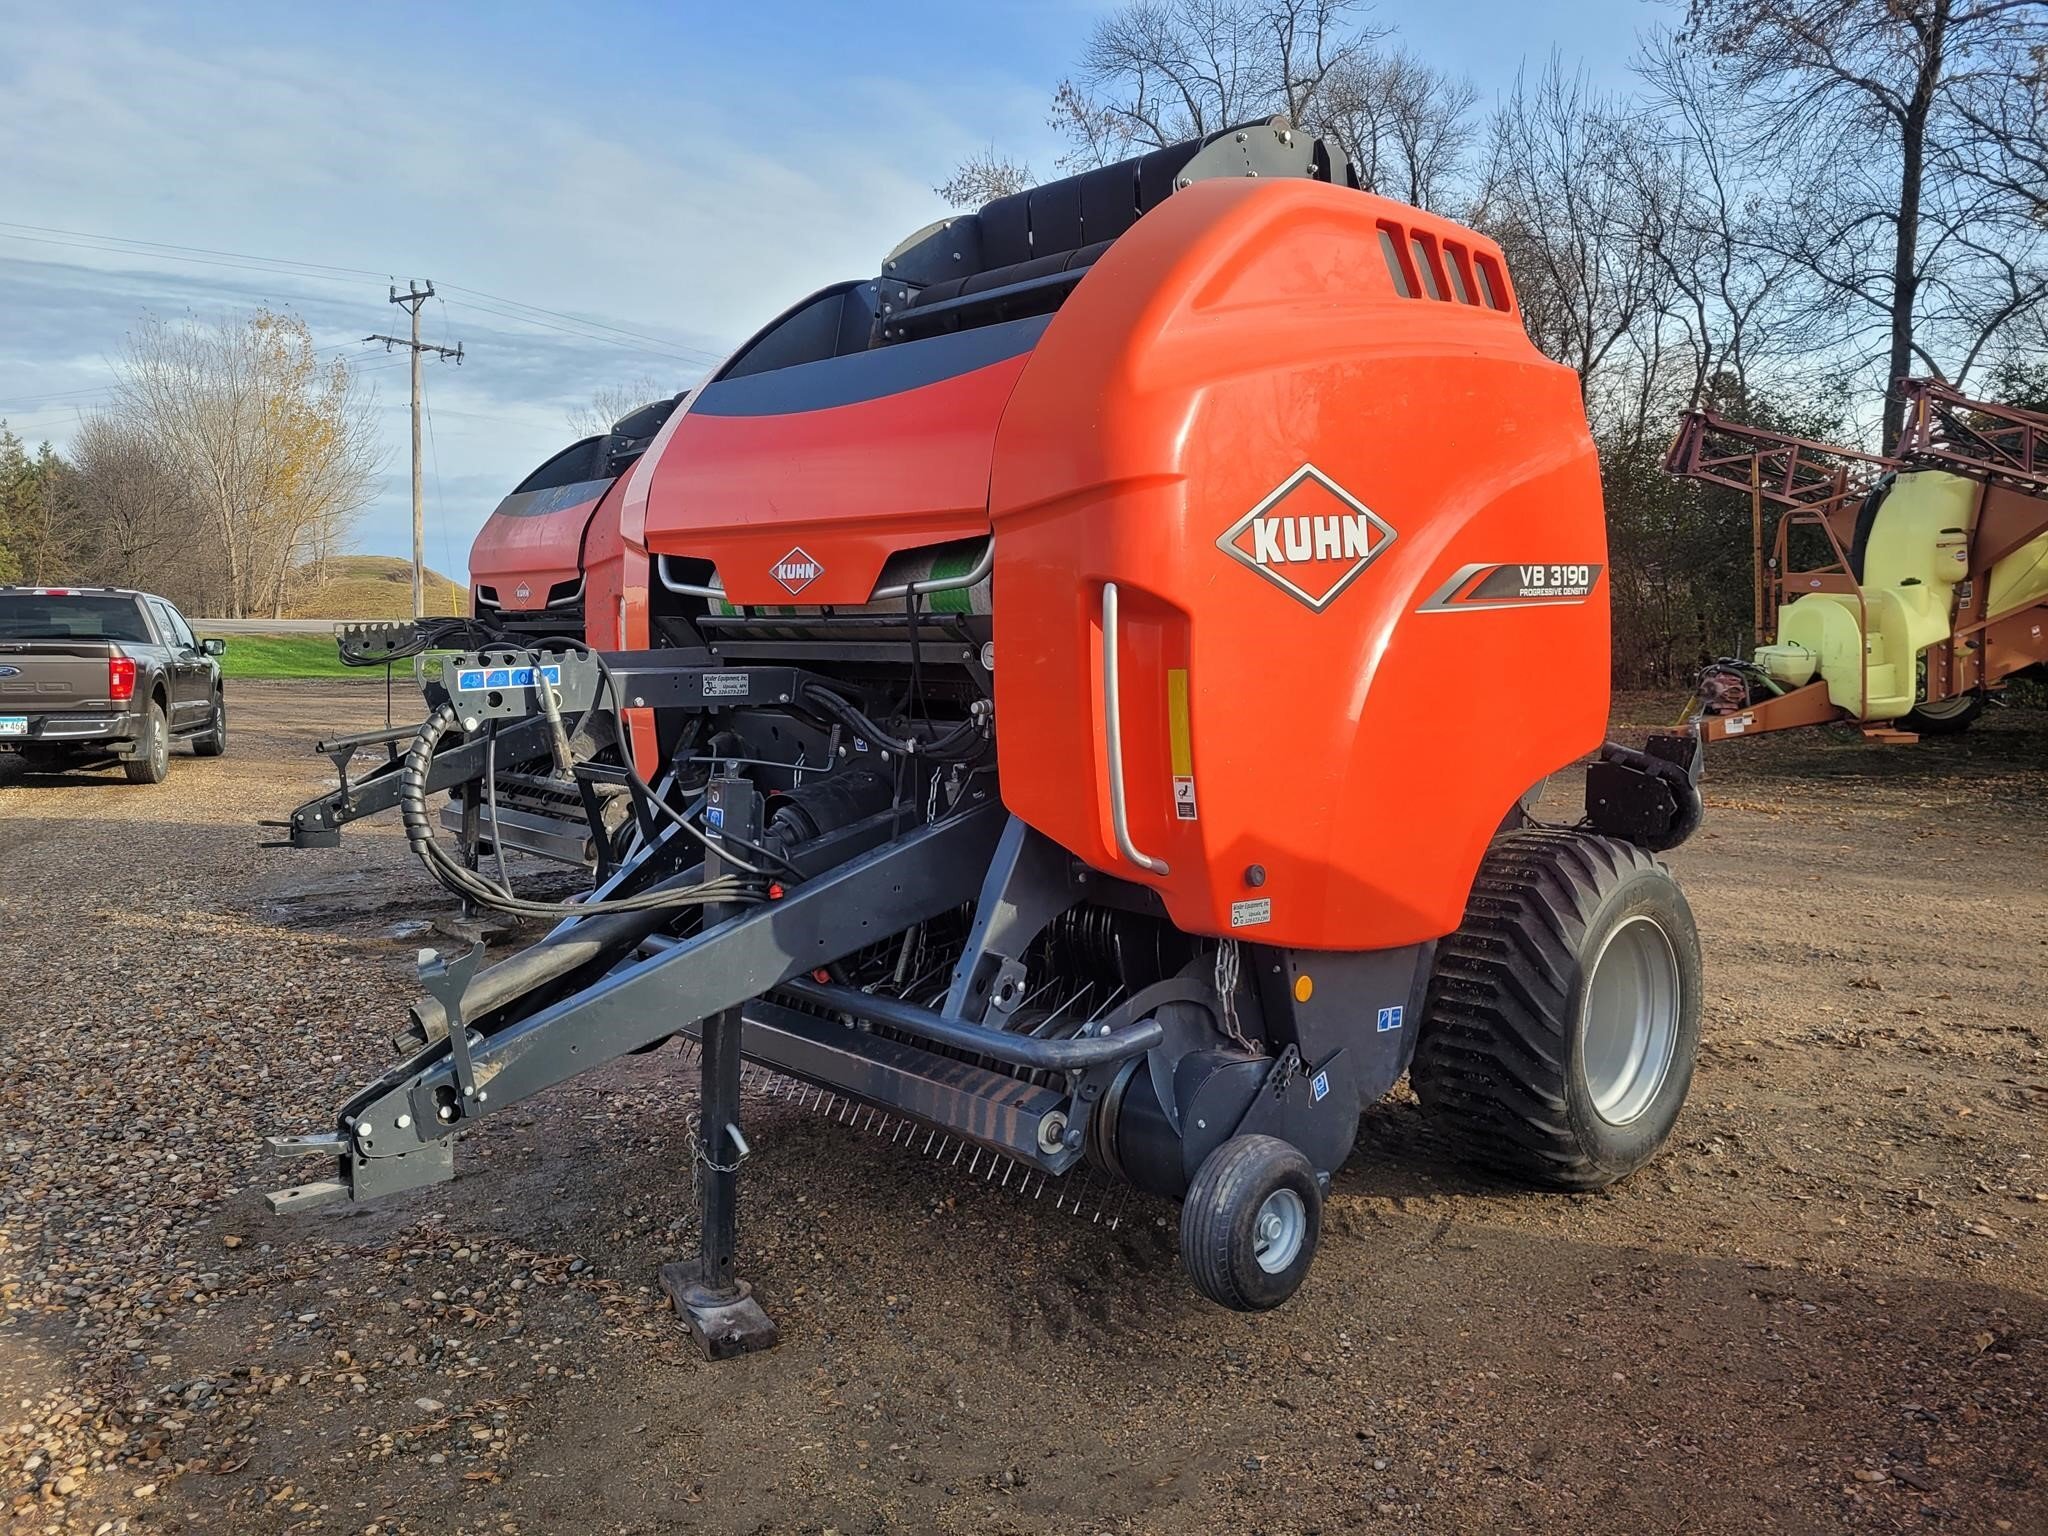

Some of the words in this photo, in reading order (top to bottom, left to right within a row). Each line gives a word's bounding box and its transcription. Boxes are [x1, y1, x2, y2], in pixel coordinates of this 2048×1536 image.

[1253, 514, 1369, 564] KUHN
[778, 563, 815, 579] KUHN
[1520, 565, 1545, 587] VB
[1550, 565, 1589, 586] 3190
[1520, 588, 1562, 597] PROGRESSIVE
[1563, 587, 1588, 596] DENSITY
